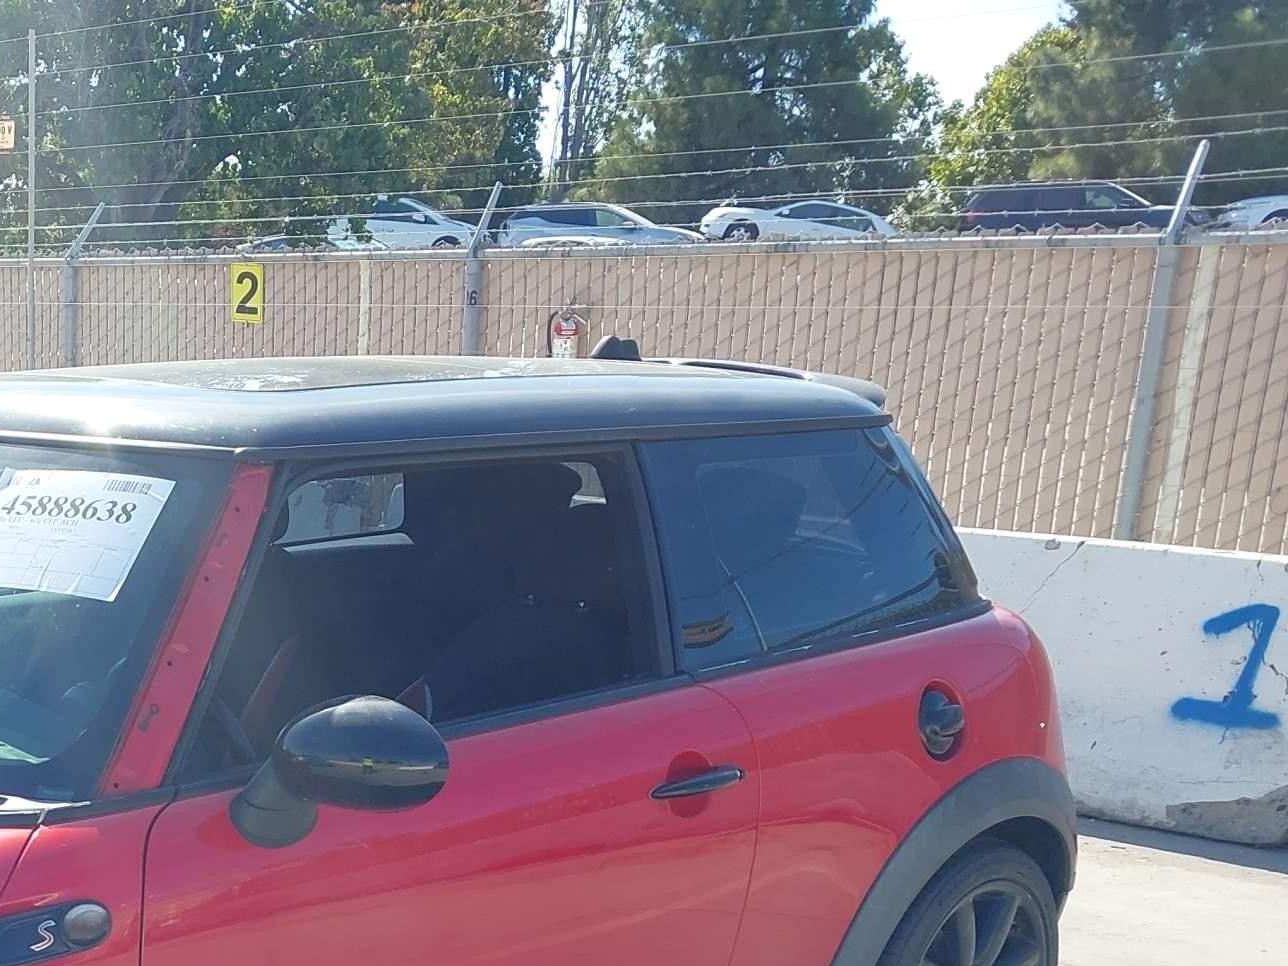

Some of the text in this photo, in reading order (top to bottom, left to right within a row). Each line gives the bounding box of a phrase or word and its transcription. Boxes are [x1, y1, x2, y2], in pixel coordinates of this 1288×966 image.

[234, 271, 260, 316] 2
[0, 493, 138, 525] 45888638
[1170, 603, 1283, 730] 1
[29, 919, 57, 952] S
